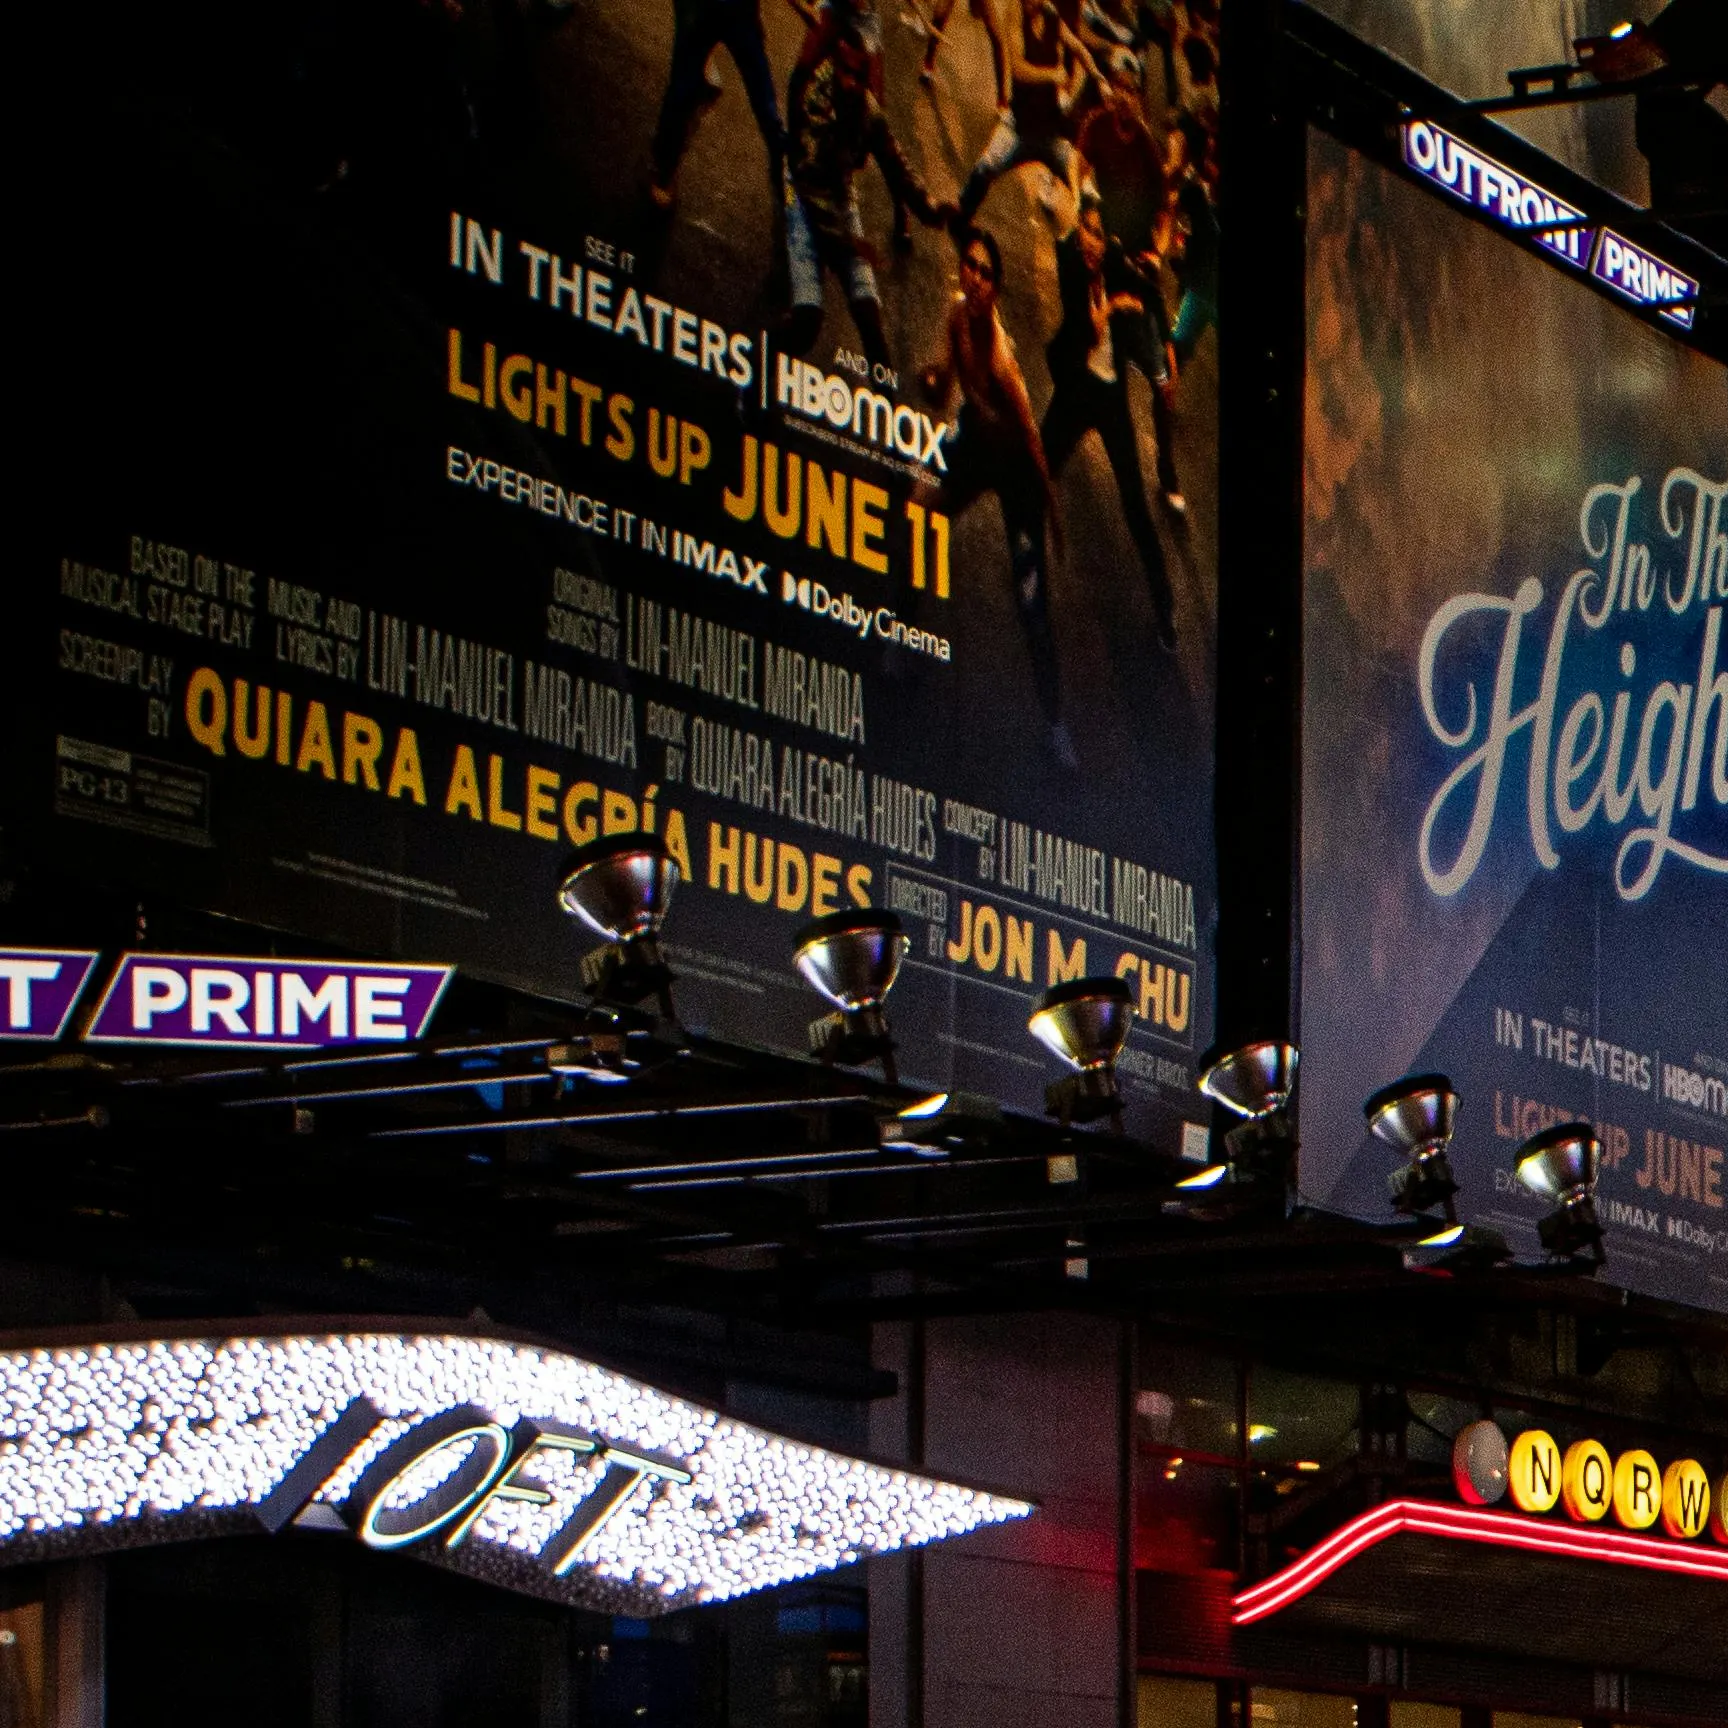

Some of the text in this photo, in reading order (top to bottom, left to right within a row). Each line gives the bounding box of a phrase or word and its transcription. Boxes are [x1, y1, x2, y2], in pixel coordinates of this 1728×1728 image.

[584, 232, 637, 275] SEE IT
[1409, 120, 1689, 318] OUTFRONT PRIME
[449, 211, 753, 389] IN THEATERS
[834, 346, 898, 391] AND ON
[446, 327, 635, 463] LIGHTS
[647, 407, 712, 485] UP
[722, 433, 890, 576] JUNE
[906, 501, 951, 599] 11
[130, 533, 256, 609] BASED ON THE
[446, 445, 952, 662] EXPERIENCE IT IN IMAX Dolby Cinema
[1578, 476, 1654, 629] In
[60, 556, 256, 650] MUSICAL STAGE PLAY
[267, 575, 361, 642] MUSIC AND
[58, 627, 175, 695] SCREENPLAY
[276, 622, 361, 685] LYRICS BY
[366, 607, 638, 770] LIN-MANUEL MIRANDA
[626, 591, 866, 746] LIN-MANUEL MIRANDA
[147, 696, 172, 740] BY
[182, 665, 429, 807] QUIARA
[706, 820, 874, 917] HUDES
[689, 714, 937, 863] QUIARA ALEGRÍA HUDES
[1001, 815, 1197, 950] LIN-MANUEL MIRANDA
[946, 899, 1034, 984] JON
[130, 965, 413, 1041] PRIME
[1495, 1007, 1523, 1050] IN
[1531, 1017, 1651, 1091] THEATERS
[1494, 1090, 1591, 1141] LIG
[1635, 1128, 1724, 1208] JUNE
[1609, 1200, 1660, 1234] IMAX
[1681, 1216, 1715, 1250] Dolby
[1530, 1445, 1554, 1496] N
[1583, 1456, 1605, 1506] Q
[1633, 1463, 1654, 1513] R
[1680, 1477, 1706, 1530] W
